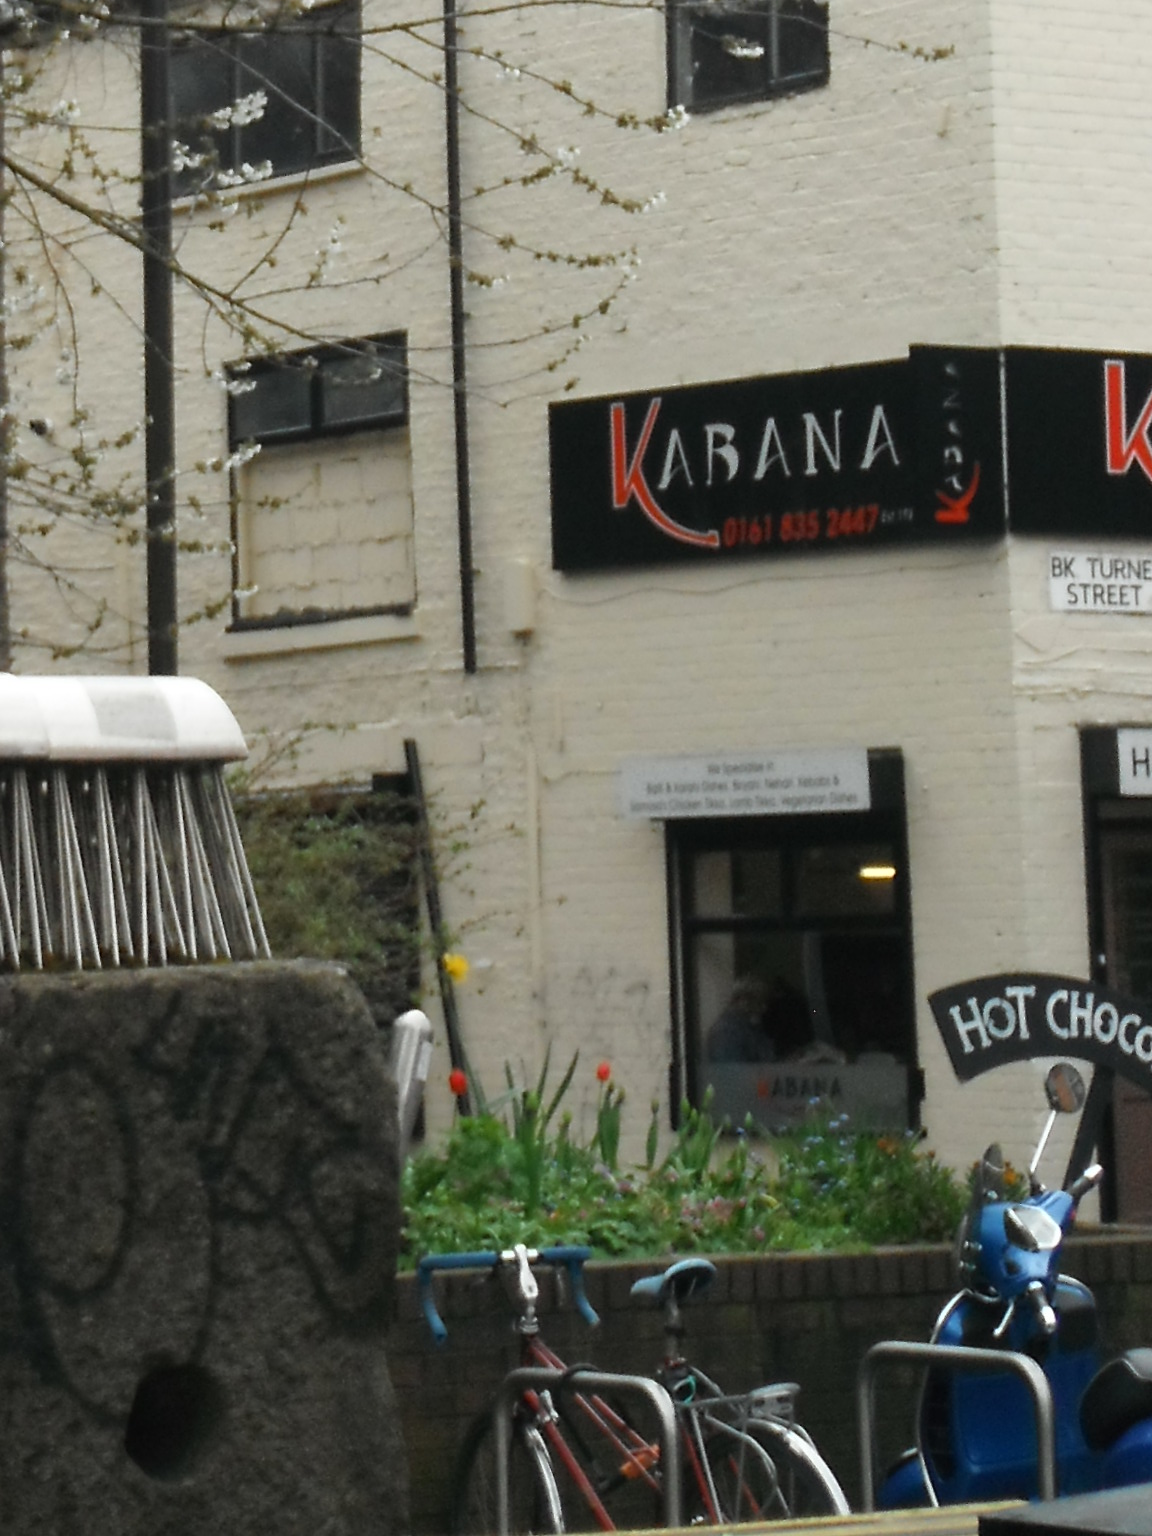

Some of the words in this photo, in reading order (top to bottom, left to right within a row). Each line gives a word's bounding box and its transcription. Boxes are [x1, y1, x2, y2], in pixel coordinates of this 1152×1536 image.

[610, 397, 901, 547] KABANA
[723, 515, 772, 547] 0161
[780, 511, 820, 541] 835
[1051, 557, 1076, 578] BK
[1067, 583, 1142, 606] STREET
[949, 985, 1036, 1054] HOT
